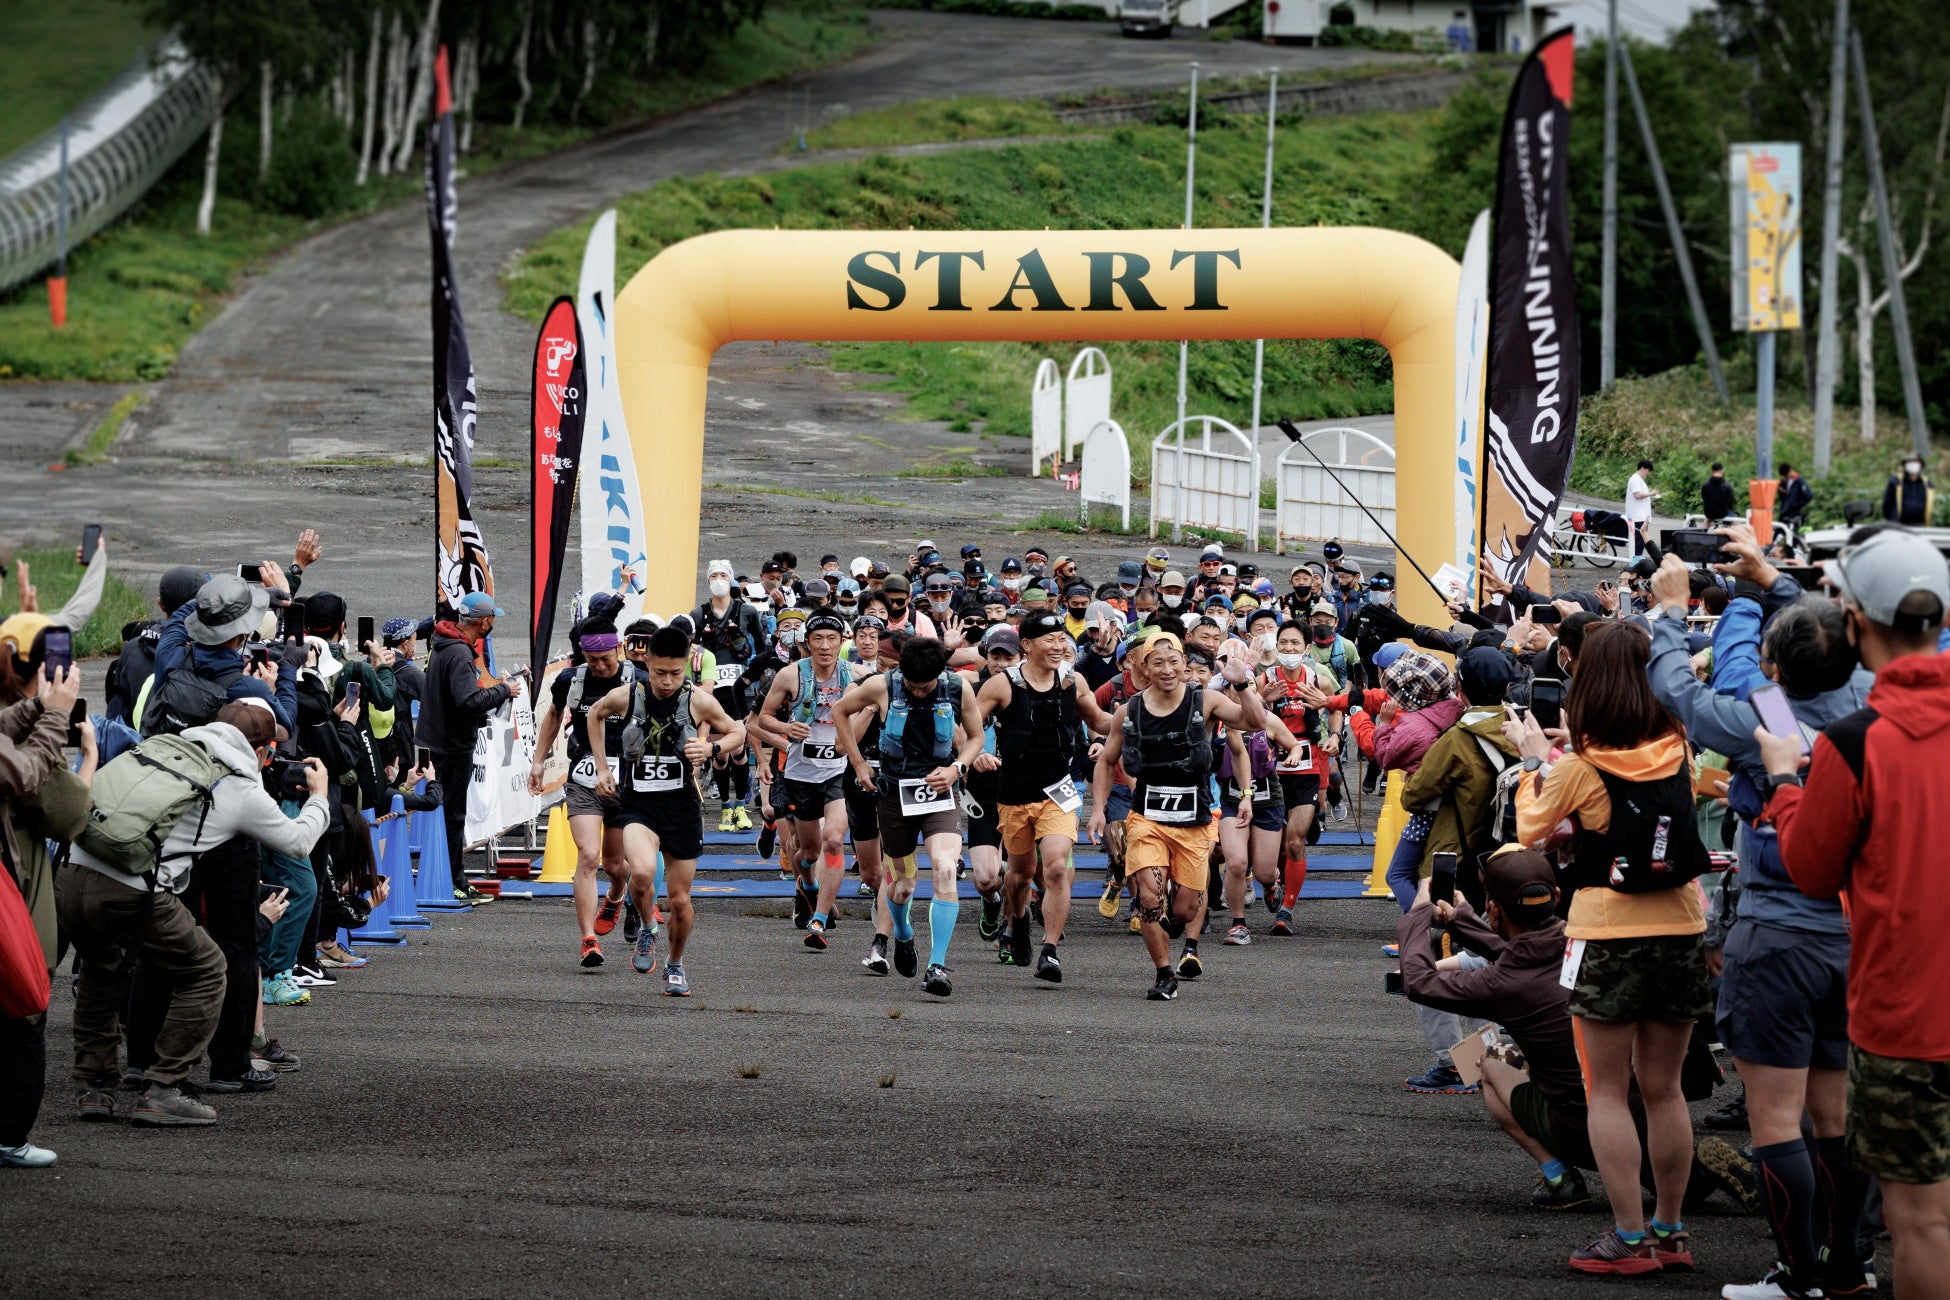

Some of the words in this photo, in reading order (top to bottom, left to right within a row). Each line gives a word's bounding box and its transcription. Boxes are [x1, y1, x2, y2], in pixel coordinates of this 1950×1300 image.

[846, 247, 1241, 311] START
[815, 745, 835, 759] 76
[575, 761, 617, 777] 207
[644, 763, 669, 780] 56
[914, 785, 938, 803] 69
[1159, 794, 1183, 811] 77
